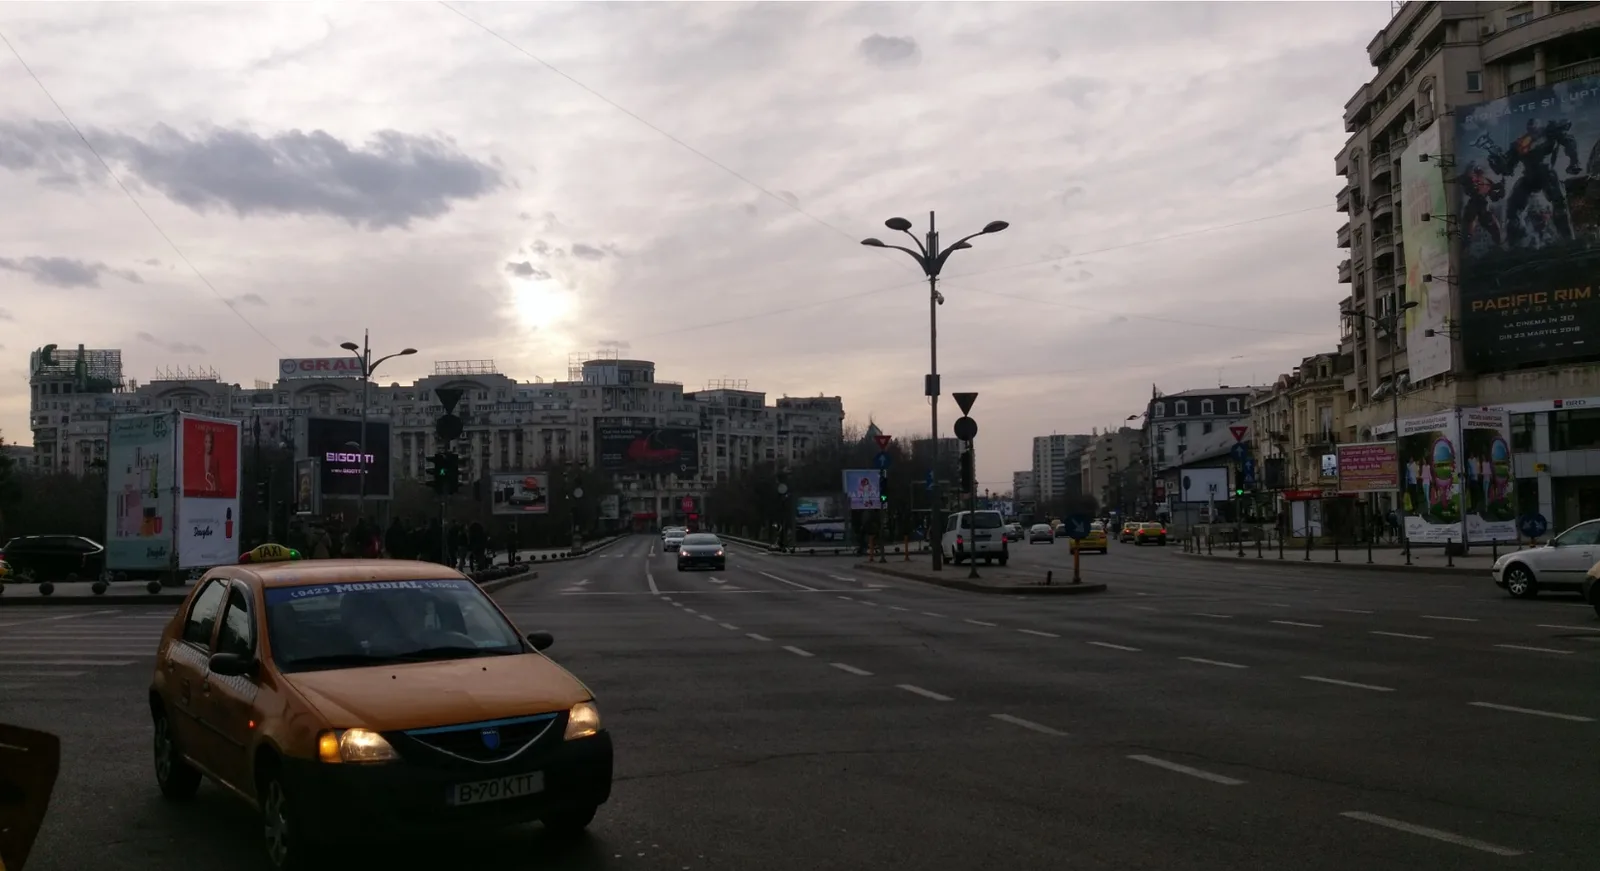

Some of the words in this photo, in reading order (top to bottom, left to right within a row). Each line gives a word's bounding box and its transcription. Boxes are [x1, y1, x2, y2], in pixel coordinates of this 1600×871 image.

[1471, 291, 1548, 312] PACIFIC
[1554, 286, 1592, 301] RIM
[1501, 301, 1579, 317] REVOLTA
[1516, 319, 1546, 327] CINEMA
[1559, 314, 1575, 322] 3D
[1499, 333, 1512, 341] DIN
[1527, 328, 1558, 337] MARTIE
[1559, 325, 1581, 334] 2018
[299, 358, 362, 371] GRAL
[1565, 399, 1586, 407] BRD
[326, 452, 374, 464] BIGOTTI
[1208, 484, 1218, 493] M
[258, 545, 282, 559] TAXI
[333, 580, 423, 593] MONDIAL
[502, 774, 534, 797] KTT
